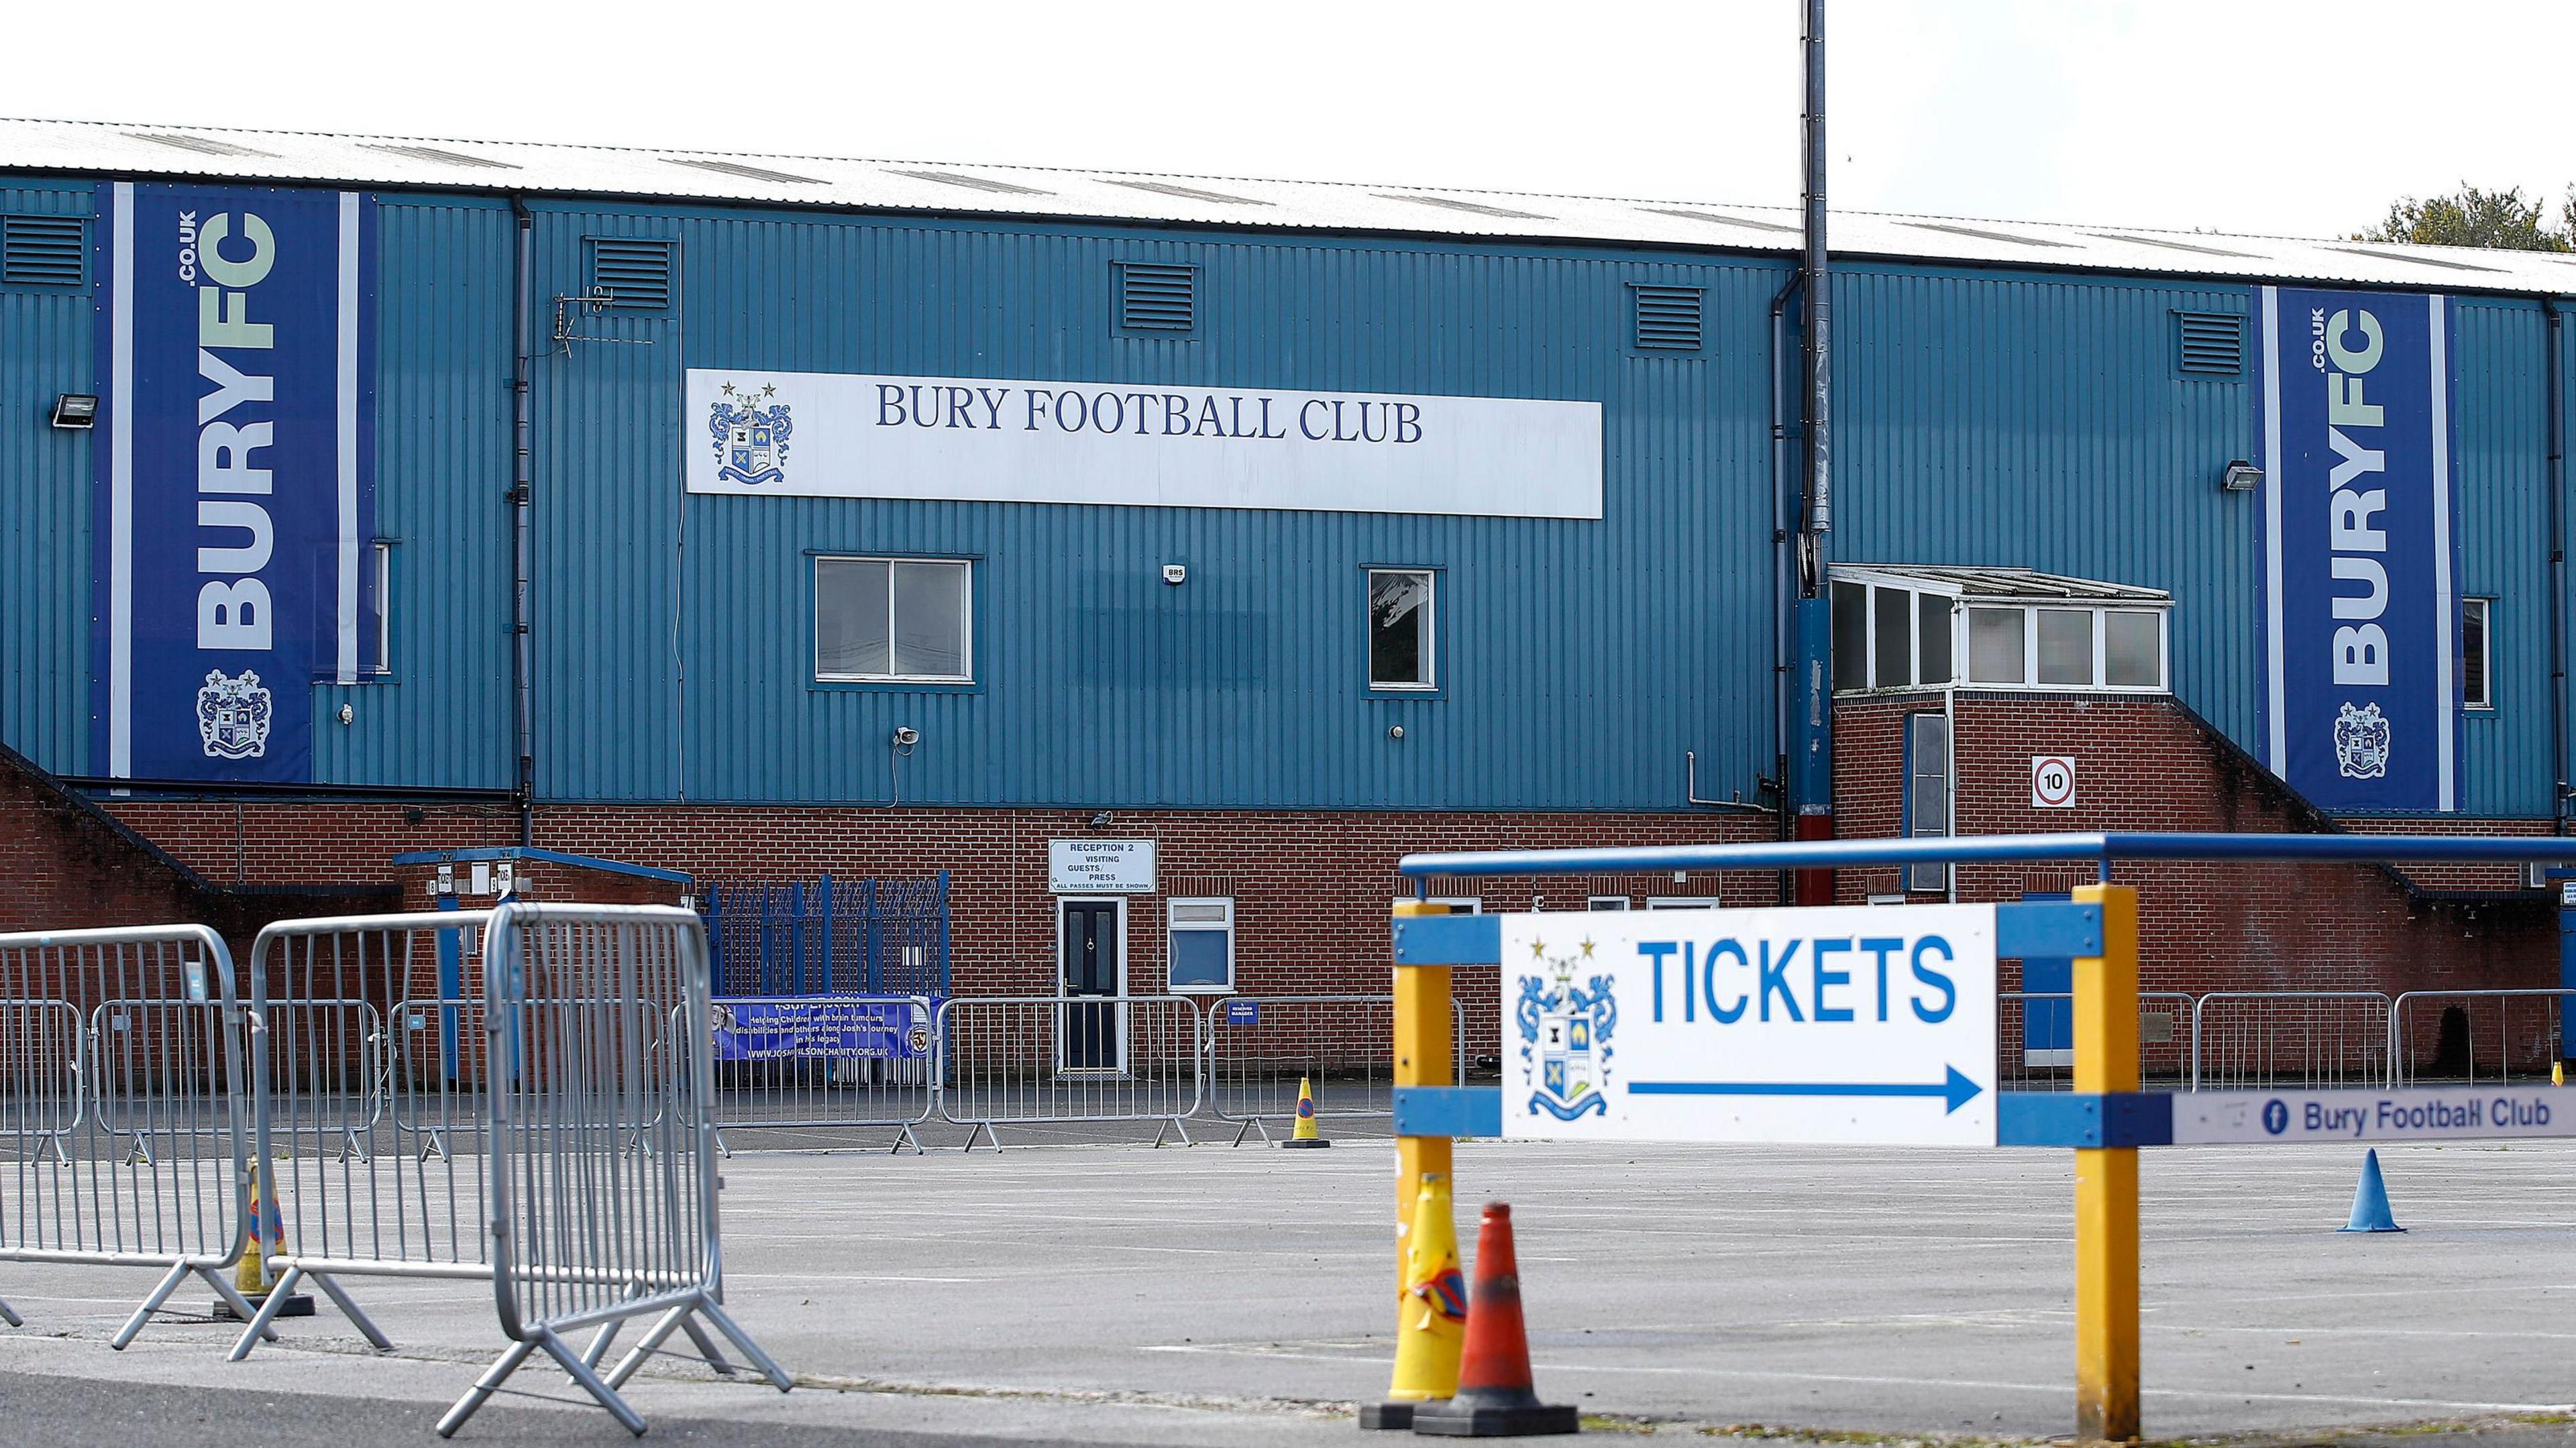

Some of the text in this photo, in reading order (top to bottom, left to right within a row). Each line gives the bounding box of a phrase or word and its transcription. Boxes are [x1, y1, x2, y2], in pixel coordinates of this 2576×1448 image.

[179, 210, 196, 287] .CO.UK
[2312, 307, 2325, 374] .CO.UK
[875, 384, 1422, 443] BURY FOOTBALL CLUB
[2044, 773, 2063, 789] 10
[1070, 844, 1134, 852] RECEPTION 2
[1085, 855, 1120, 863] VISITING
[431, 883, 435, 893] 8
[492, 879, 496, 891] 9
[1638, 935, 1955, 1023] TICKETS
[781, 1015, 811, 1023] Chidren
[842, 1024, 867, 1032] Josh's
[818, 1034, 840, 1044] legacy
[2304, 1102, 2367, 1137] Bury
[2377, 1099, 2481, 1129] Football
[2491, 1097, 2551, 1127] Club
